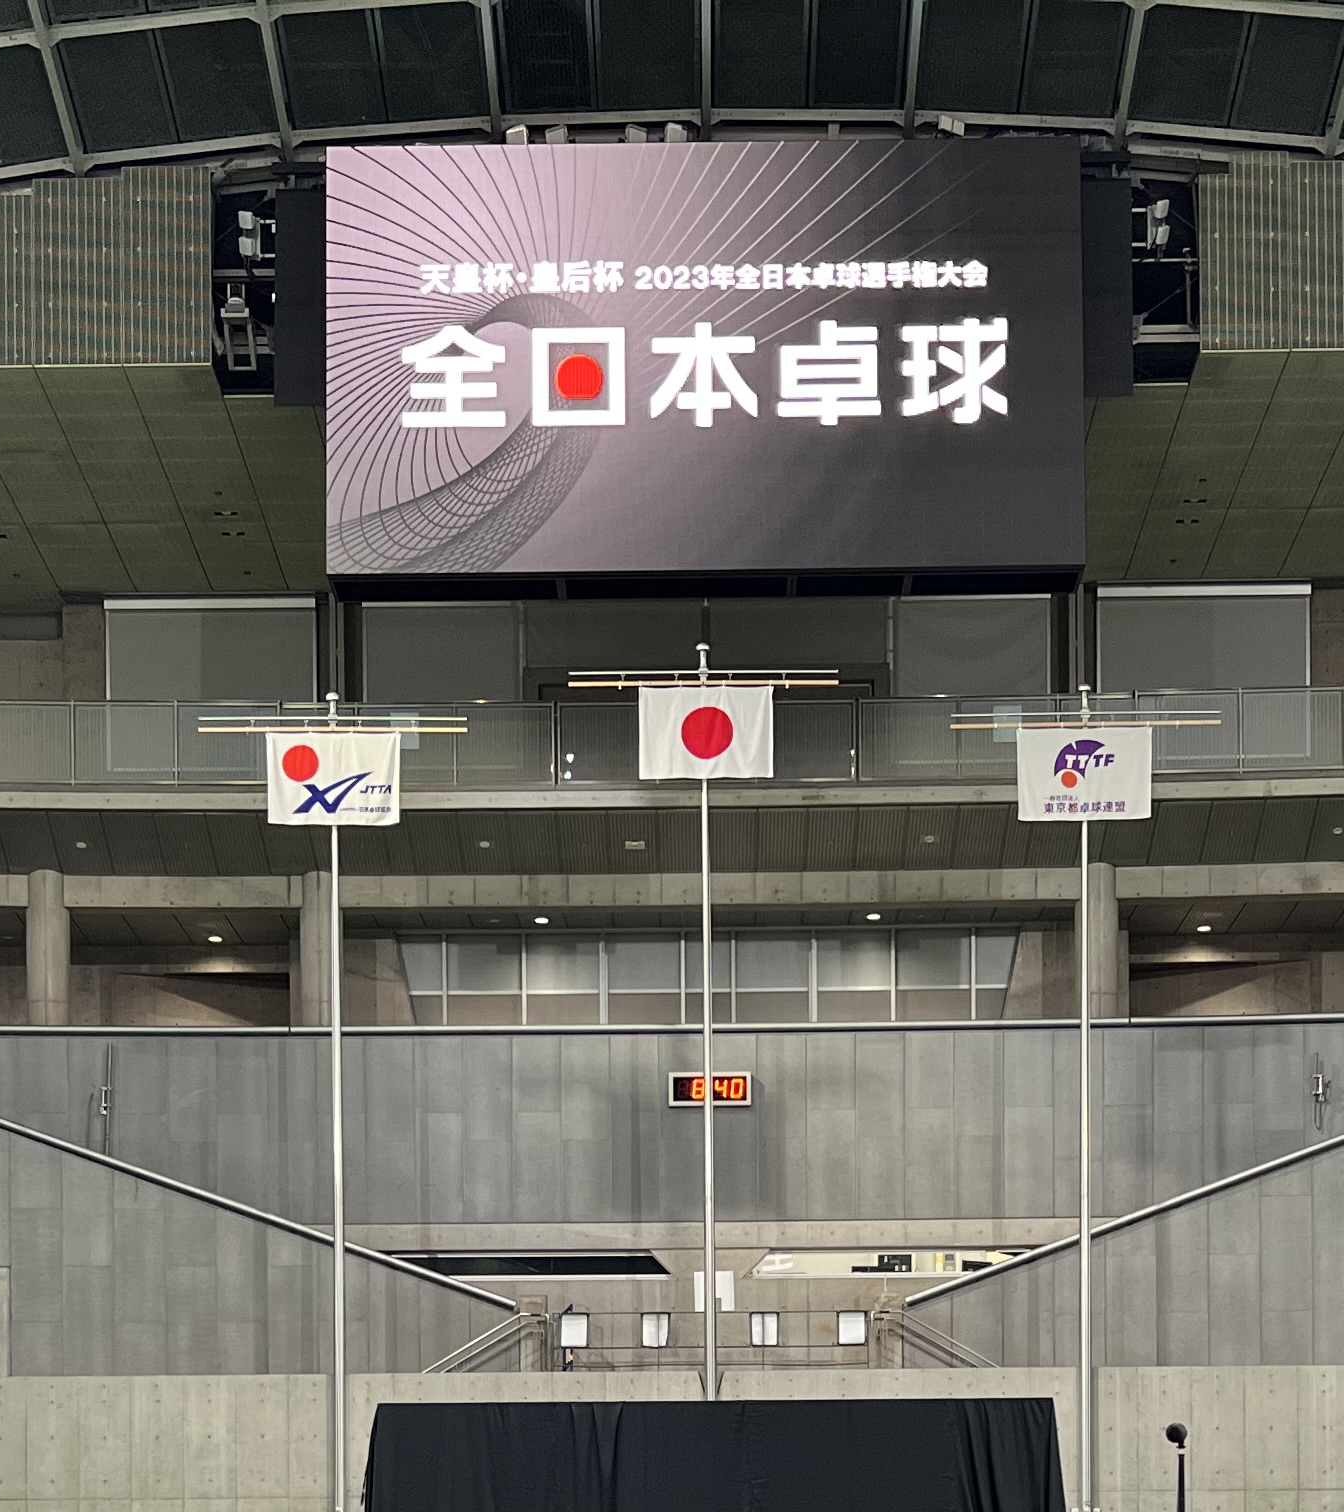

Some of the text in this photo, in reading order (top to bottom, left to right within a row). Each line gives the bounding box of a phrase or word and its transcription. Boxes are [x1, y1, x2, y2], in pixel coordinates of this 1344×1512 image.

[420, 260, 989, 294] 天皇杯・皇后杯 2023年全日本卓球選手権大会
[401, 317, 1009, 428] 全日本卓球
[359, 784, 392, 795] JTTA
